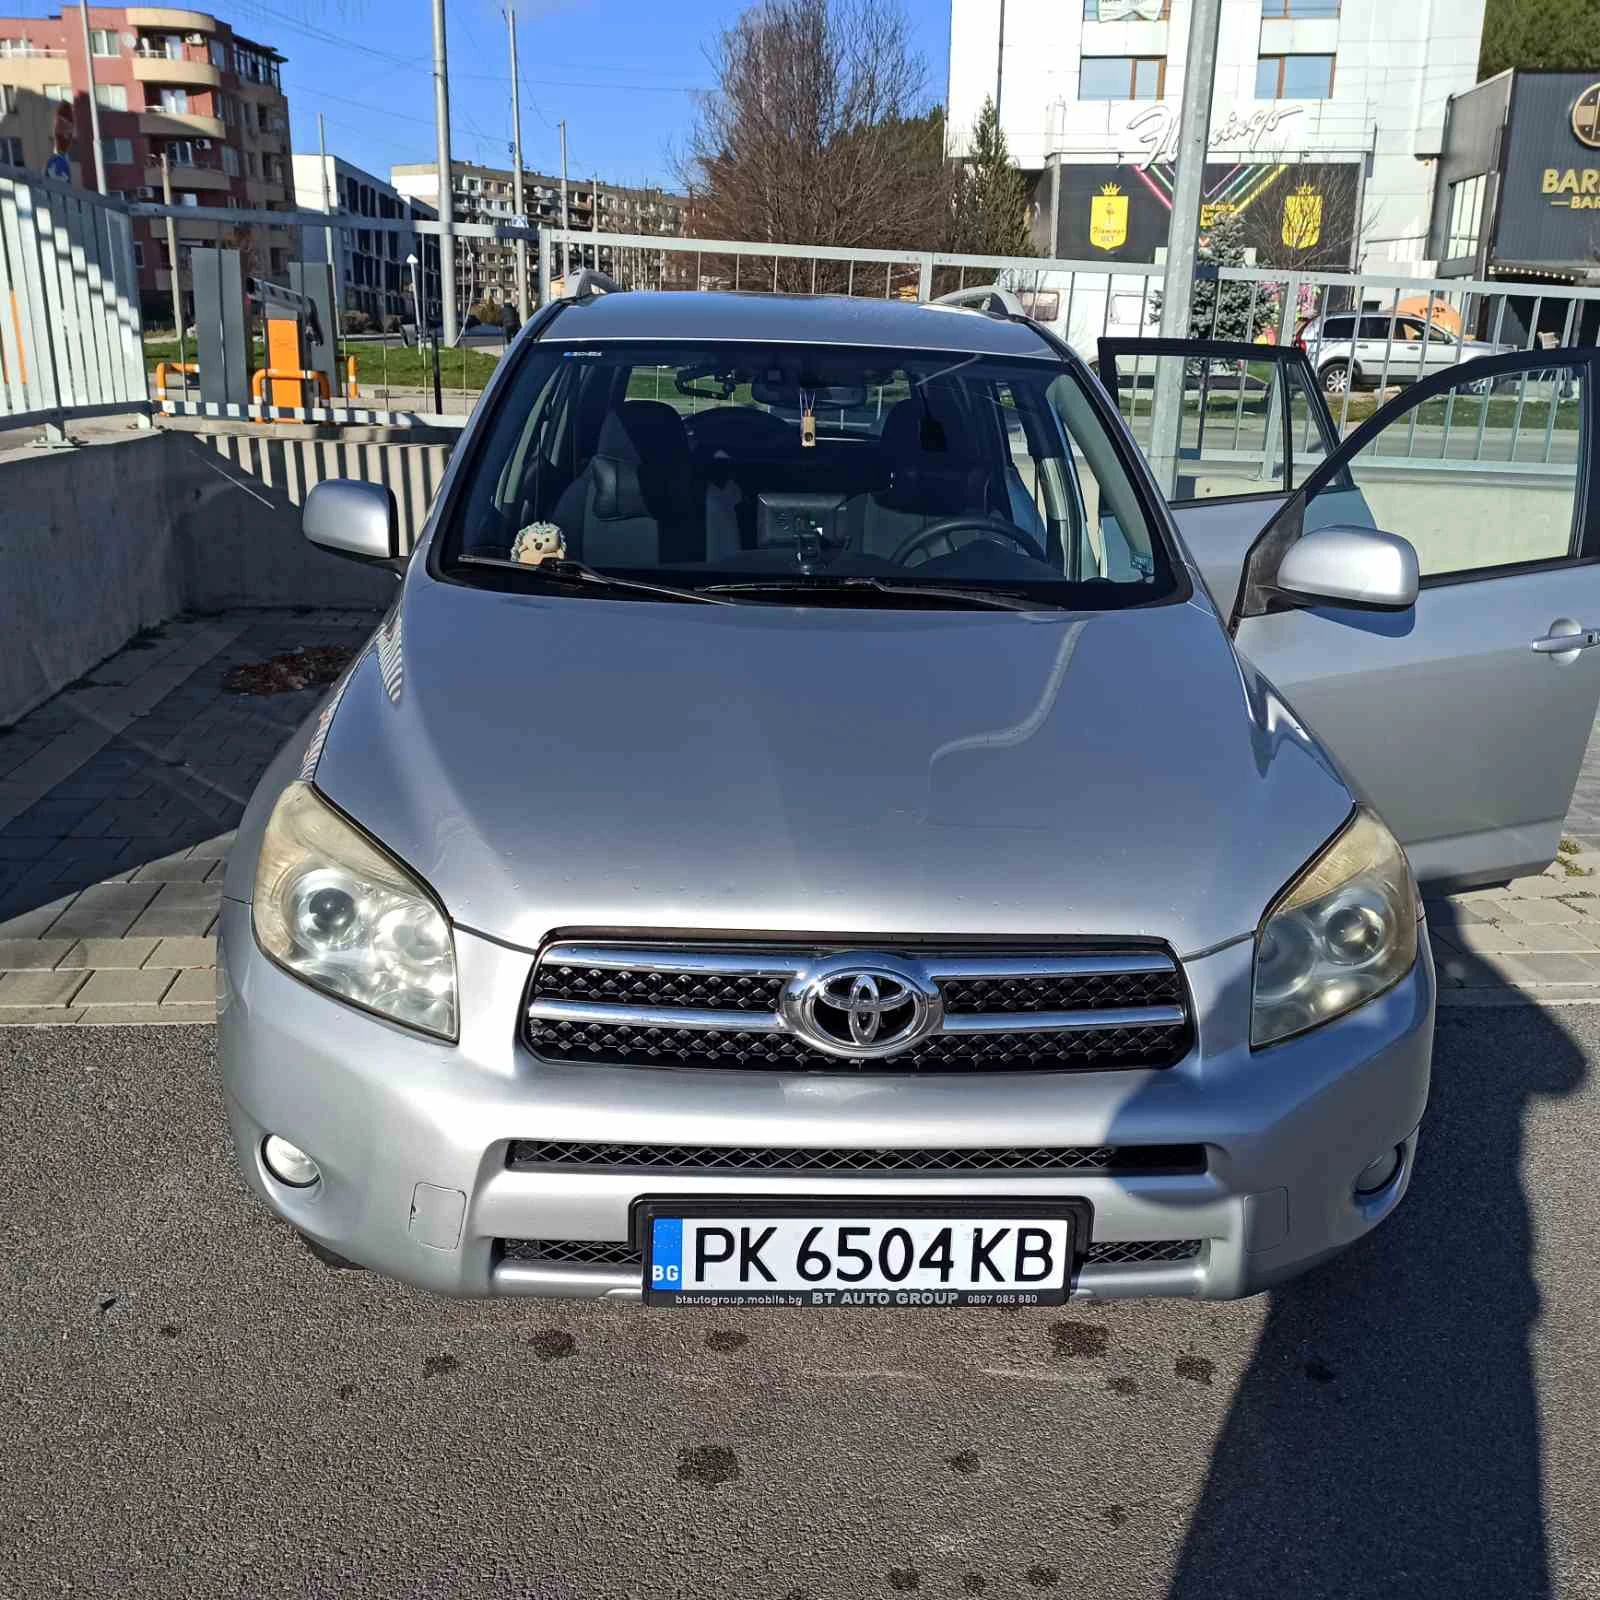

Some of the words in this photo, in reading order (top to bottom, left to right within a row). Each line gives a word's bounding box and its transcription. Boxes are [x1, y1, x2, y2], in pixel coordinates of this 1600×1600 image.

[1542, 168, 1600, 193] BAR
[695, 1226, 778, 1282] PK
[796, 1226, 954, 1283] 6504
[970, 1227, 1054, 1282] KB
[652, 1264, 679, 1281] BG
[675, 1295, 803, 1306] btautogroup.mobile.bg
[811, 1292, 836, 1305] BT
[840, 1292, 890, 1305] AUTO
[895, 1291, 959, 1305] GROUP
[967, 1294, 993, 1304] 0897
